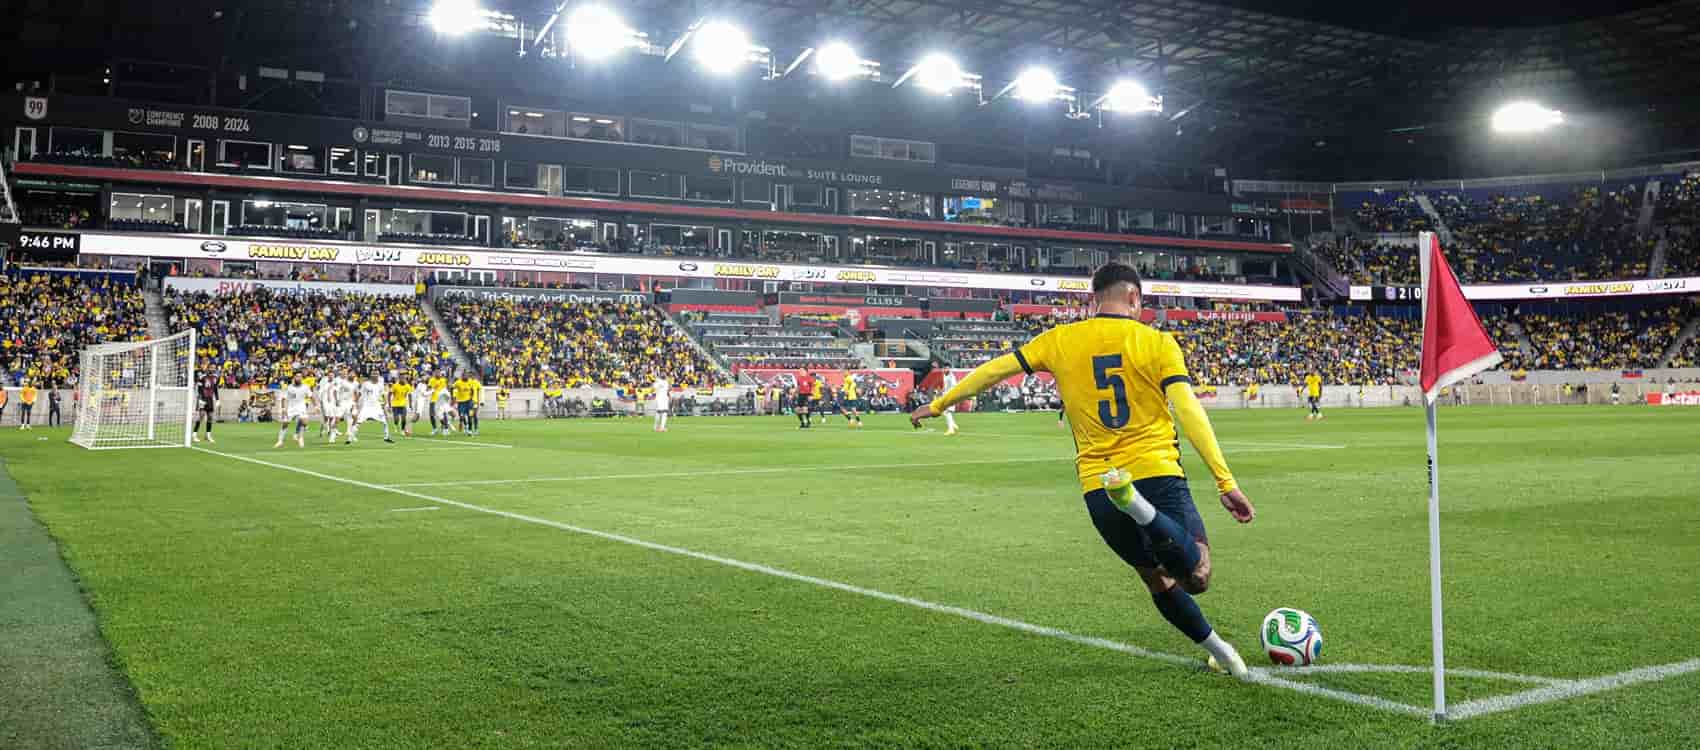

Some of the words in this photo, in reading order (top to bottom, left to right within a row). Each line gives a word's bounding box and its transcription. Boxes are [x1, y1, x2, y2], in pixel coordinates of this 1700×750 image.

[29, 100, 43, 114] 99
[192, 114, 219, 131] 2008
[223, 117, 250, 133] 2024
[428, 134, 450, 149] 2013
[454, 137, 476, 151] 2015
[724, 158, 788, 177] Provident
[808, 170, 836, 181] SUITE
[841, 172, 882, 185] LOUNGE
[19, 234, 50, 249] 9:46
[53, 236, 75, 249] PM
[248, 245, 306, 258] FAMILY
[308, 247, 339, 260] DAY
[417, 252, 454, 265] JUNE
[455, 255, 471, 266] 14
[714, 264, 755, 277] FAMILY
[757, 267, 780, 279] DAY
[837, 270, 864, 281] JUNE
[1399, 287, 1406, 300] 2
[1566, 285, 1607, 295] FAMILY
[1609, 283, 1633, 293] DAY
[1092, 353, 1130, 429] 5
